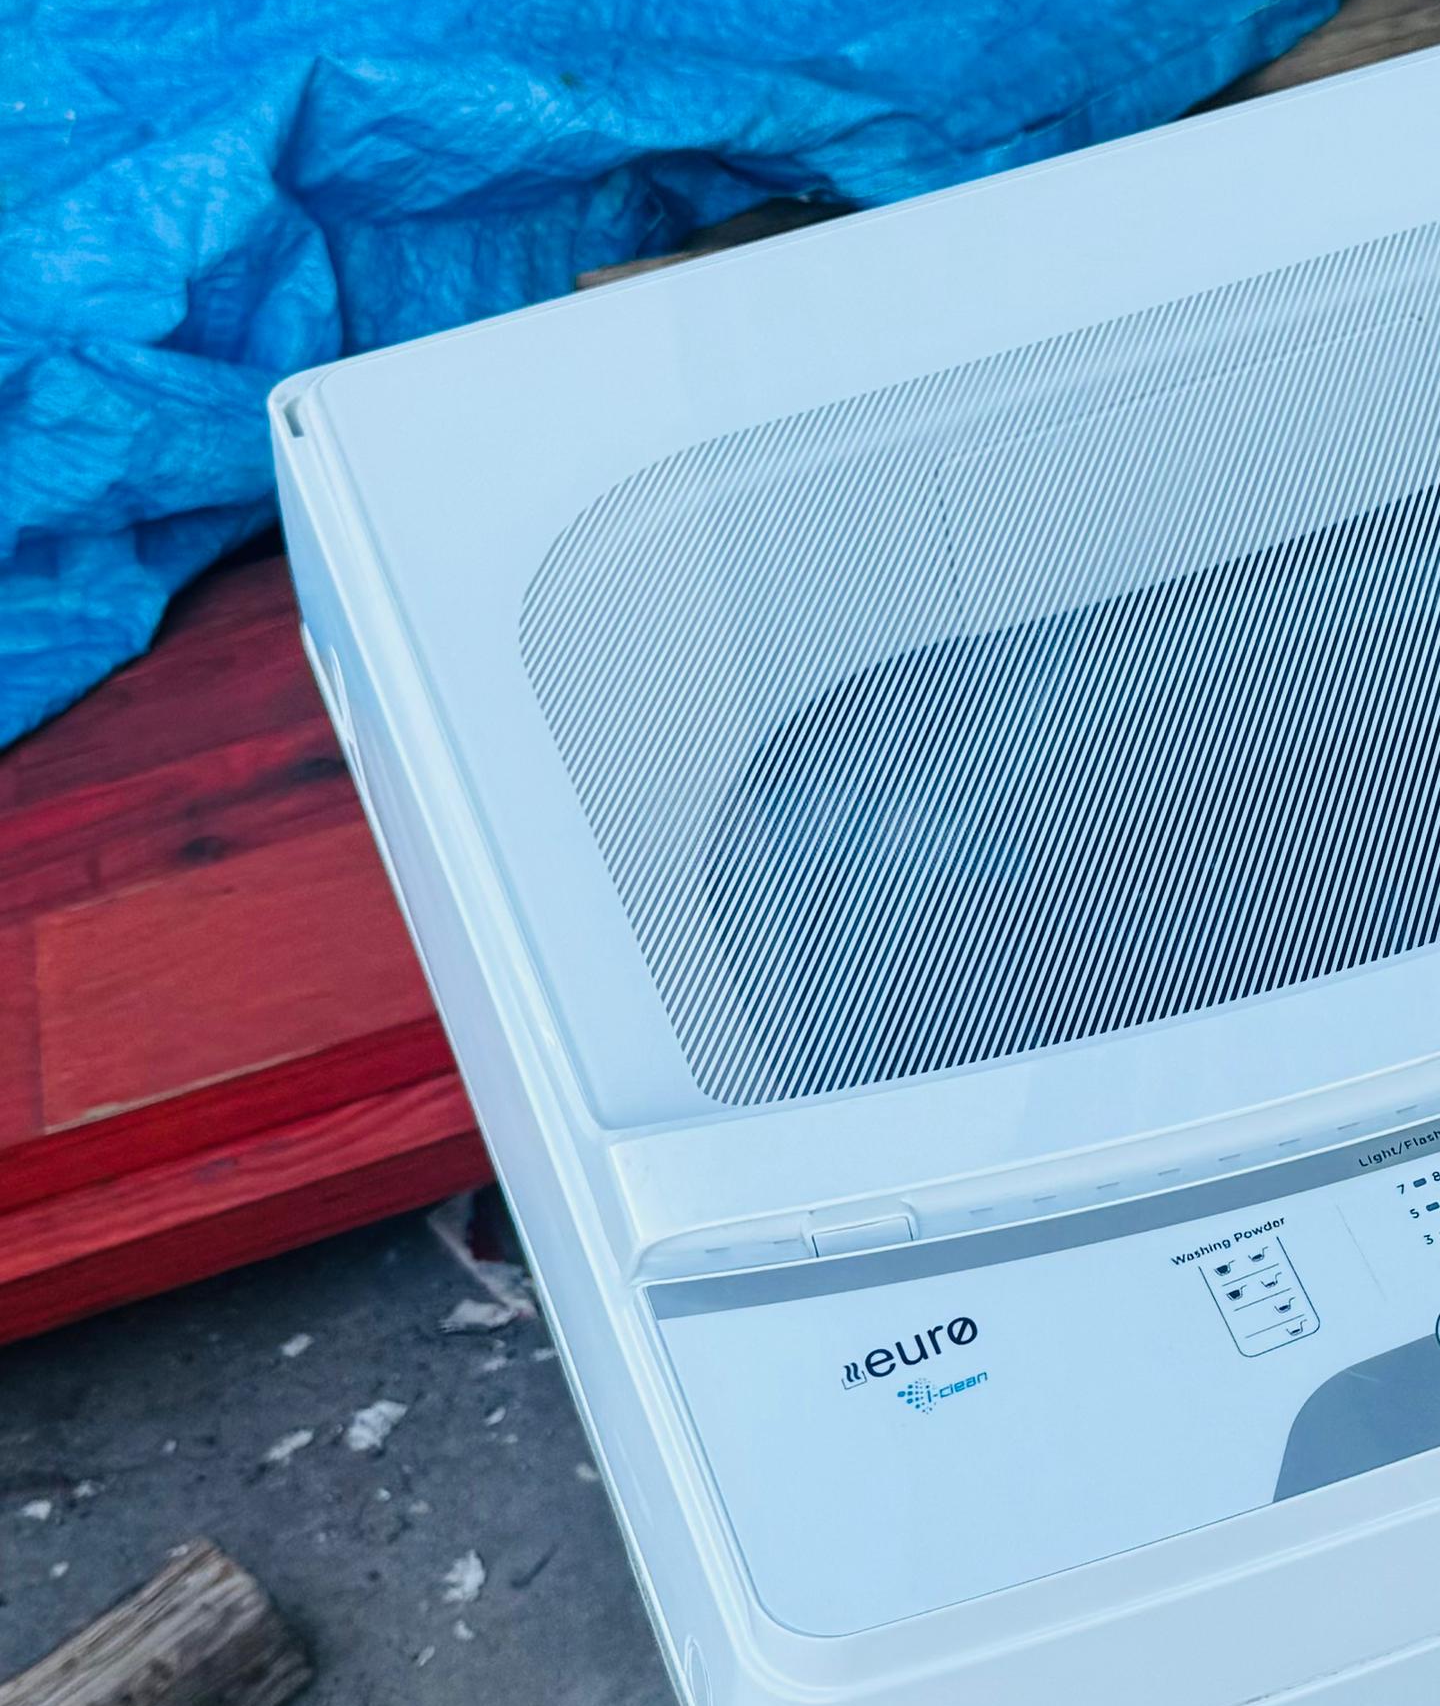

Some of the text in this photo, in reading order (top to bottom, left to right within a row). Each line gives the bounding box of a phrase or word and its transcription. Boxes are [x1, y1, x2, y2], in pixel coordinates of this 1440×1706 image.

[1396, 1183, 1405, 1194] 7
[1410, 1208, 1420, 1219] 5
[1171, 1217, 1286, 1266] Washing Powder
[1424, 1234, 1434, 1245] 3
[926, 1371, 988, 1403] i-clean
